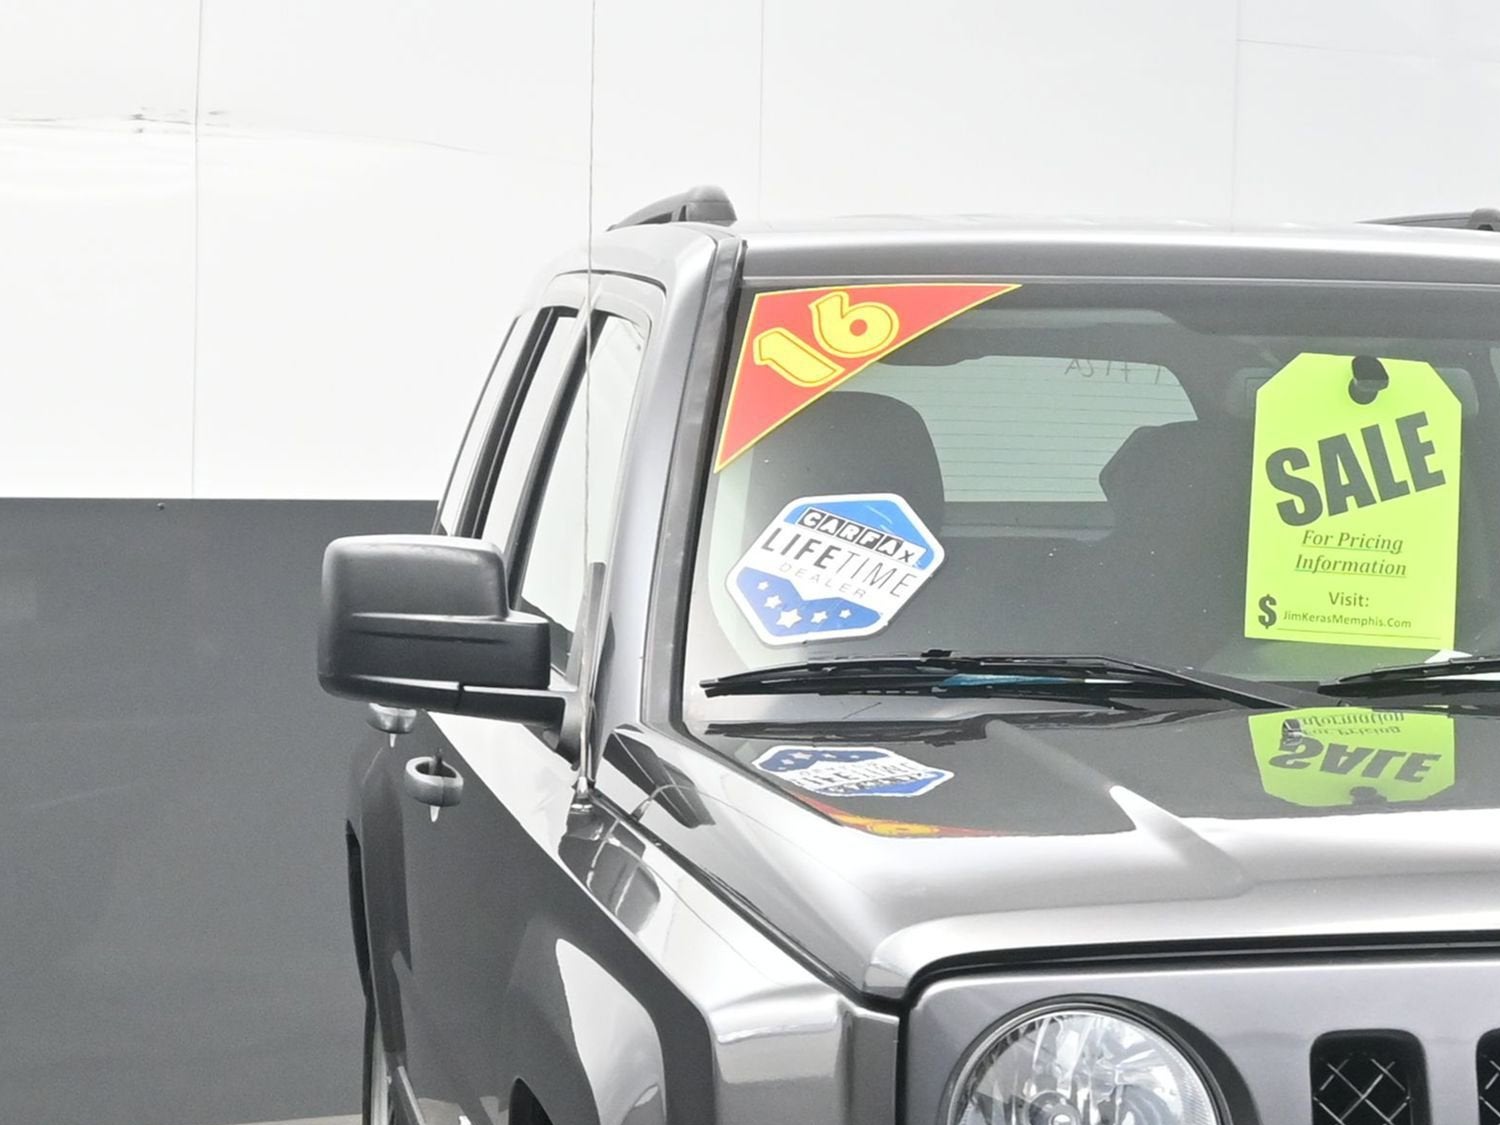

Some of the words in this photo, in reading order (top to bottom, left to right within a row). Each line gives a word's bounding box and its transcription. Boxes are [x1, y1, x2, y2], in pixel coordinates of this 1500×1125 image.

[753, 290, 900, 387] 16
[1265, 411, 1446, 527] SALE
[798, 508, 915, 563] CARFAX
[1302, 529, 1333, 546] For
[1338, 532, 1404, 555] Pricing
[761, 527, 917, 598] LIFETIME
[778, 562, 867, 598] DEALER
[1295, 554, 1407, 576] Information
[1257, 593, 1277, 629] $
[1328, 591, 1369, 608] Visit:
[1283, 610, 1412, 629] JimKerasMemphis.Com
